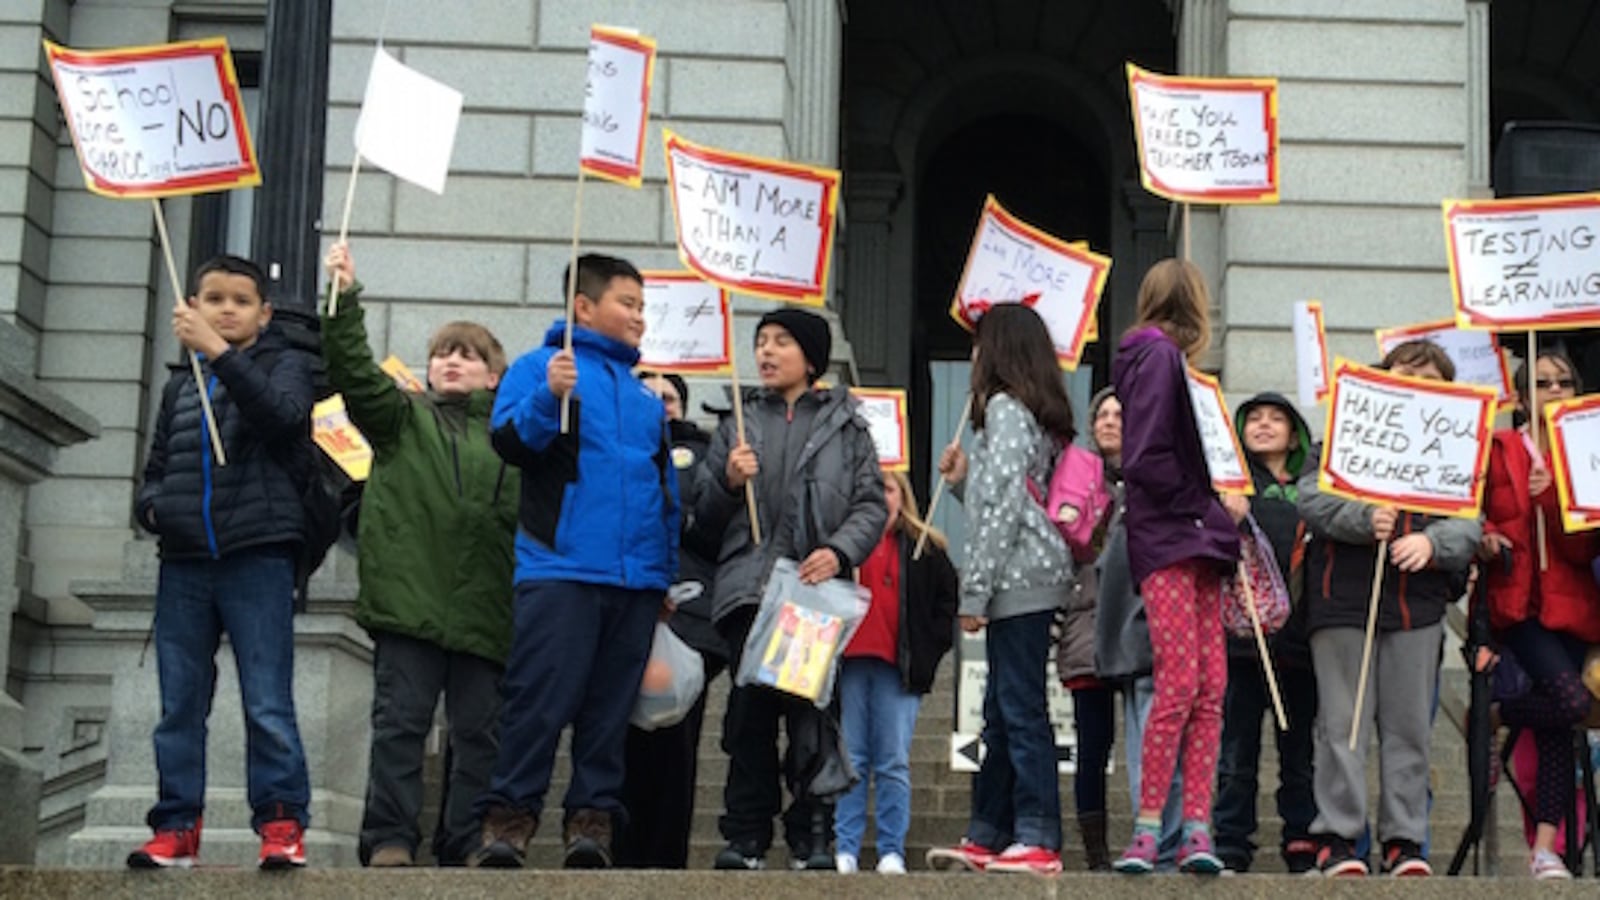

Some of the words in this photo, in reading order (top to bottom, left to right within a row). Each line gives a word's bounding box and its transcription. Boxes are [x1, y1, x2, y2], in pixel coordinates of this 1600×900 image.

[75, 67, 181, 112] School
[177, 98, 230, 147] NO
[1191, 104, 1238, 127] YOU
[1208, 130, 1228, 148] A
[702, 173, 741, 207] AM
[754, 182, 816, 220] MORE
[701, 207, 761, 244] THAN
[769, 225, 788, 251] A
[1462, 225, 1596, 256] TESTING
[1012, 248, 1071, 292] MORE
[1469, 272, 1600, 307] LEARNING
[1343, 391, 1405, 430] HAVE
[1420, 407, 1476, 439] YOU
[1339, 420, 1411, 454] FREED
[1420, 437, 1444, 459] A
[1338, 447, 1430, 485] TEACHER
